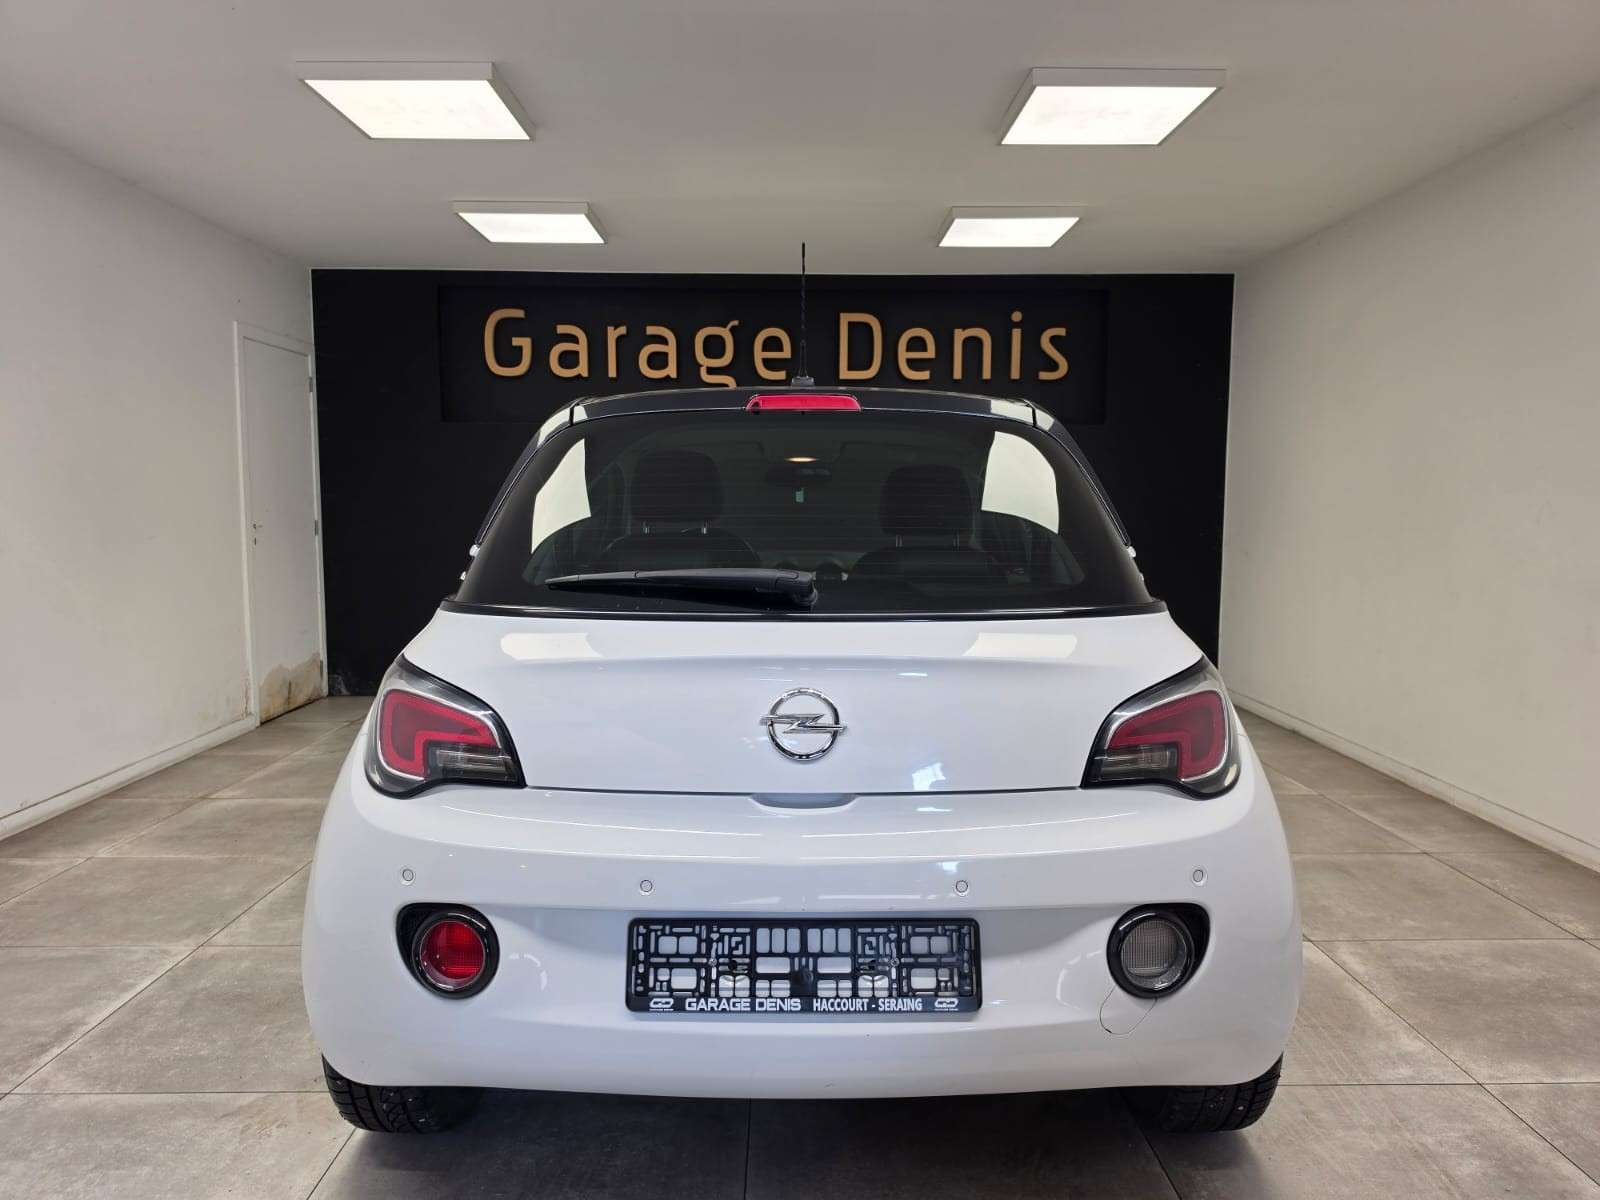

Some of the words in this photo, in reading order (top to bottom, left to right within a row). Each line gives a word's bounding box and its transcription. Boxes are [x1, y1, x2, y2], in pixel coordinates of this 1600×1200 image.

[484, 308, 792, 388] Garage
[839, 310, 1071, 381] Denis
[685, 997, 751, 1011] GARAGE
[755, 997, 802, 1011] DENIS
[813, 998, 869, 1011] HACCOURT
[878, 998, 923, 1011] SERAING
